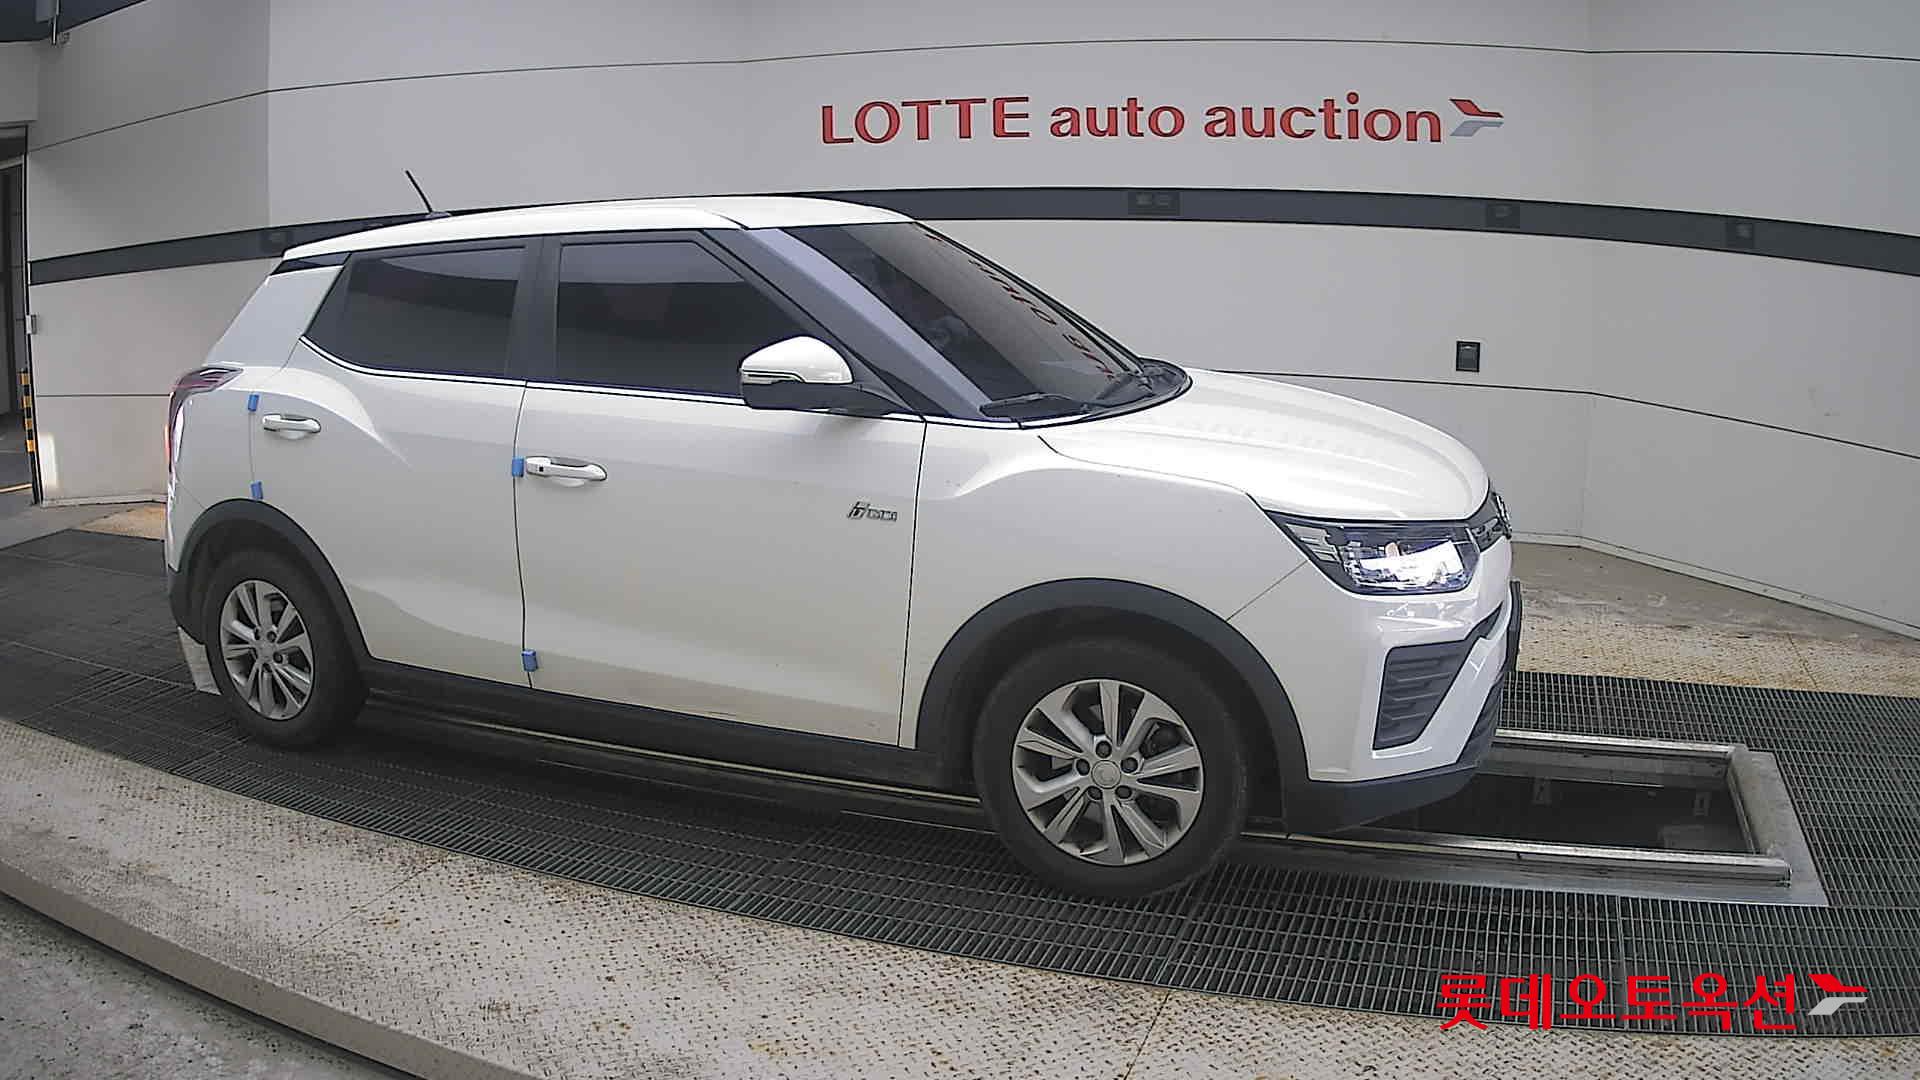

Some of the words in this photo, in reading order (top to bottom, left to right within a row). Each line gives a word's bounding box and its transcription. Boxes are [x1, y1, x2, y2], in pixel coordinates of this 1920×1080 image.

[822, 96, 1029, 144] LOTTE
[1051, 98, 1186, 137] auto
[1205, 91, 1442, 142] auction
